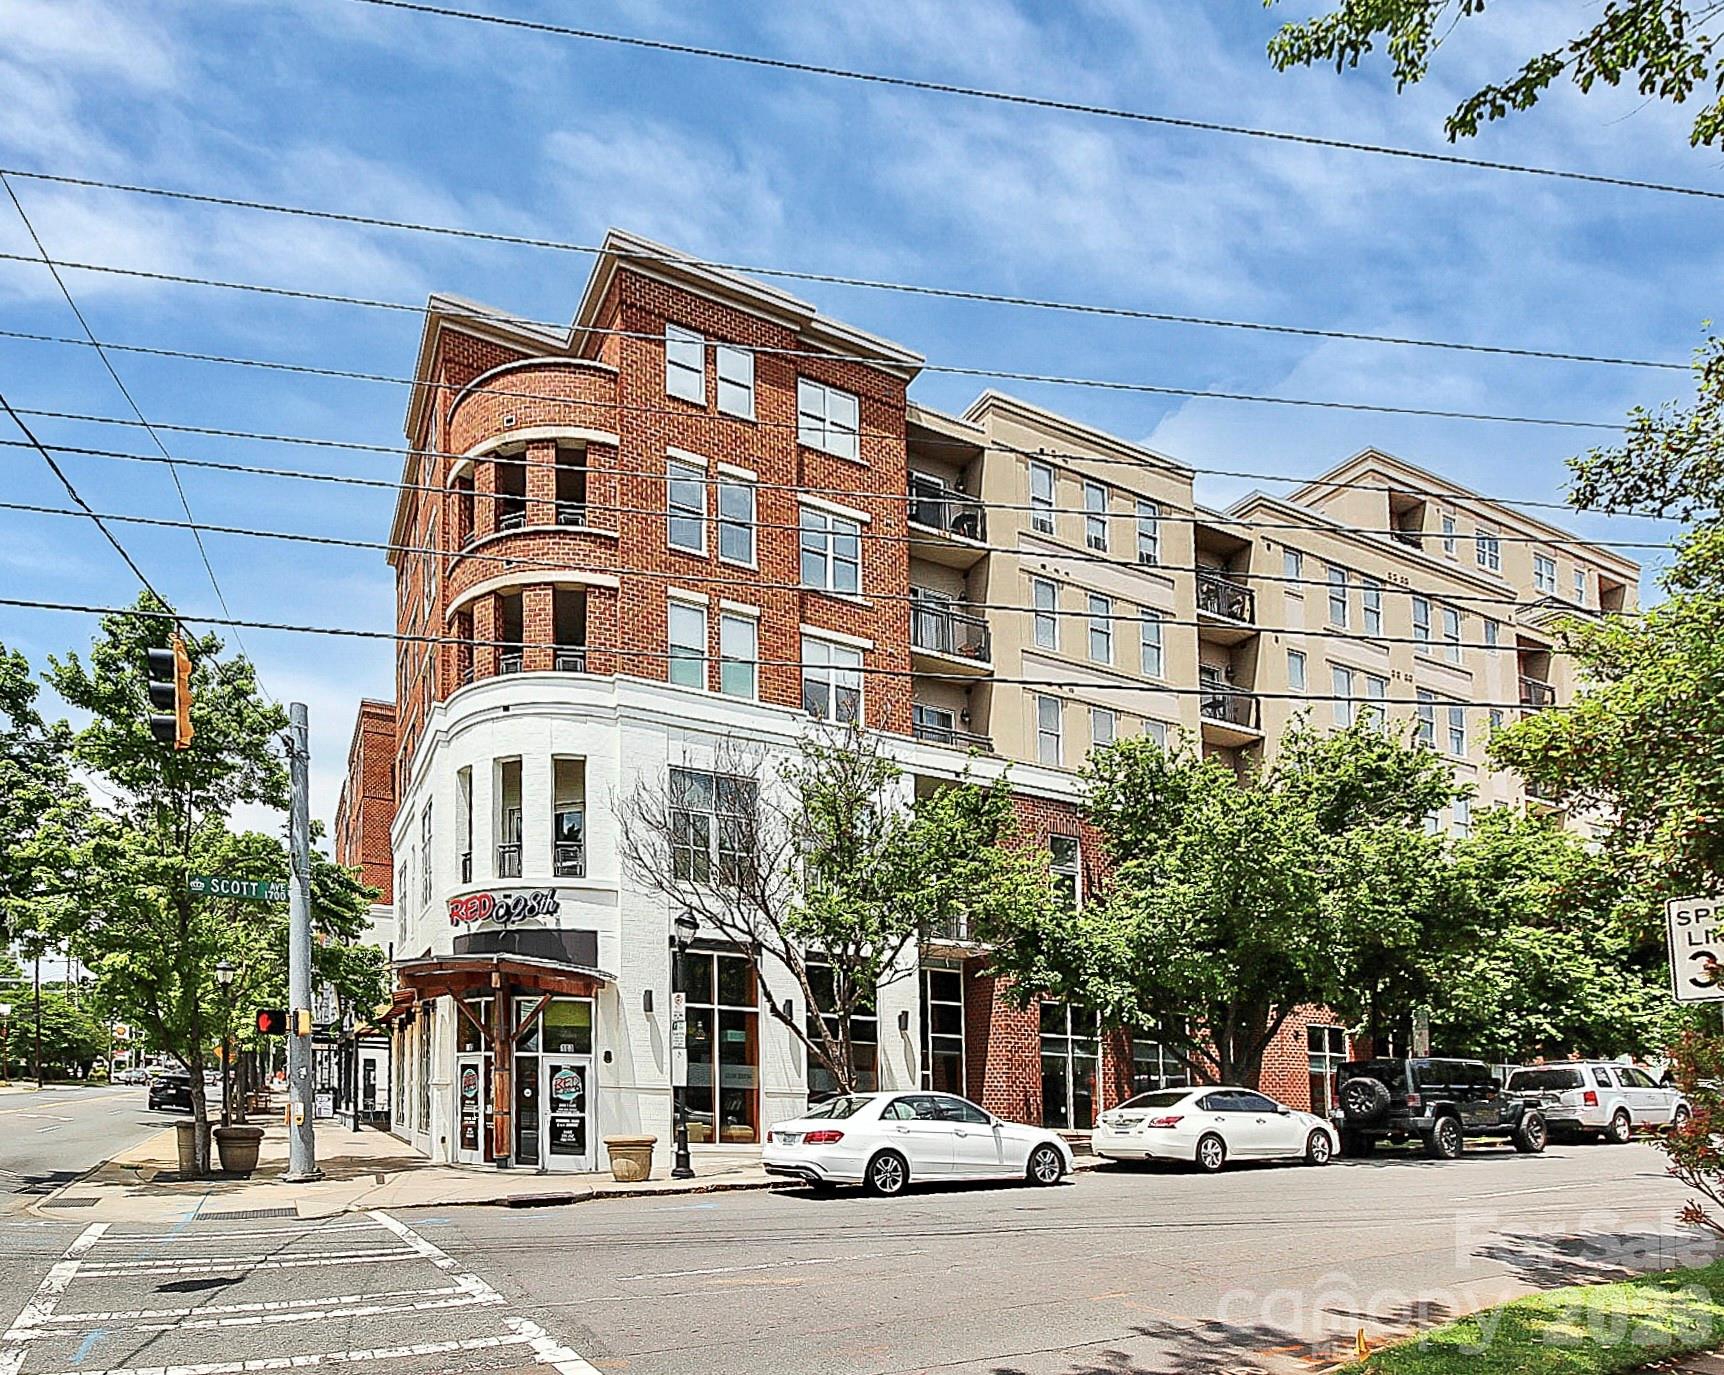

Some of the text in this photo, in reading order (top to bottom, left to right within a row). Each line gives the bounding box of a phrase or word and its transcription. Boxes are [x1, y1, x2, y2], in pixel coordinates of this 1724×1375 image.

[210, 878, 286, 897] SCOTT AVE
[264, 890, 287, 901] 1700
